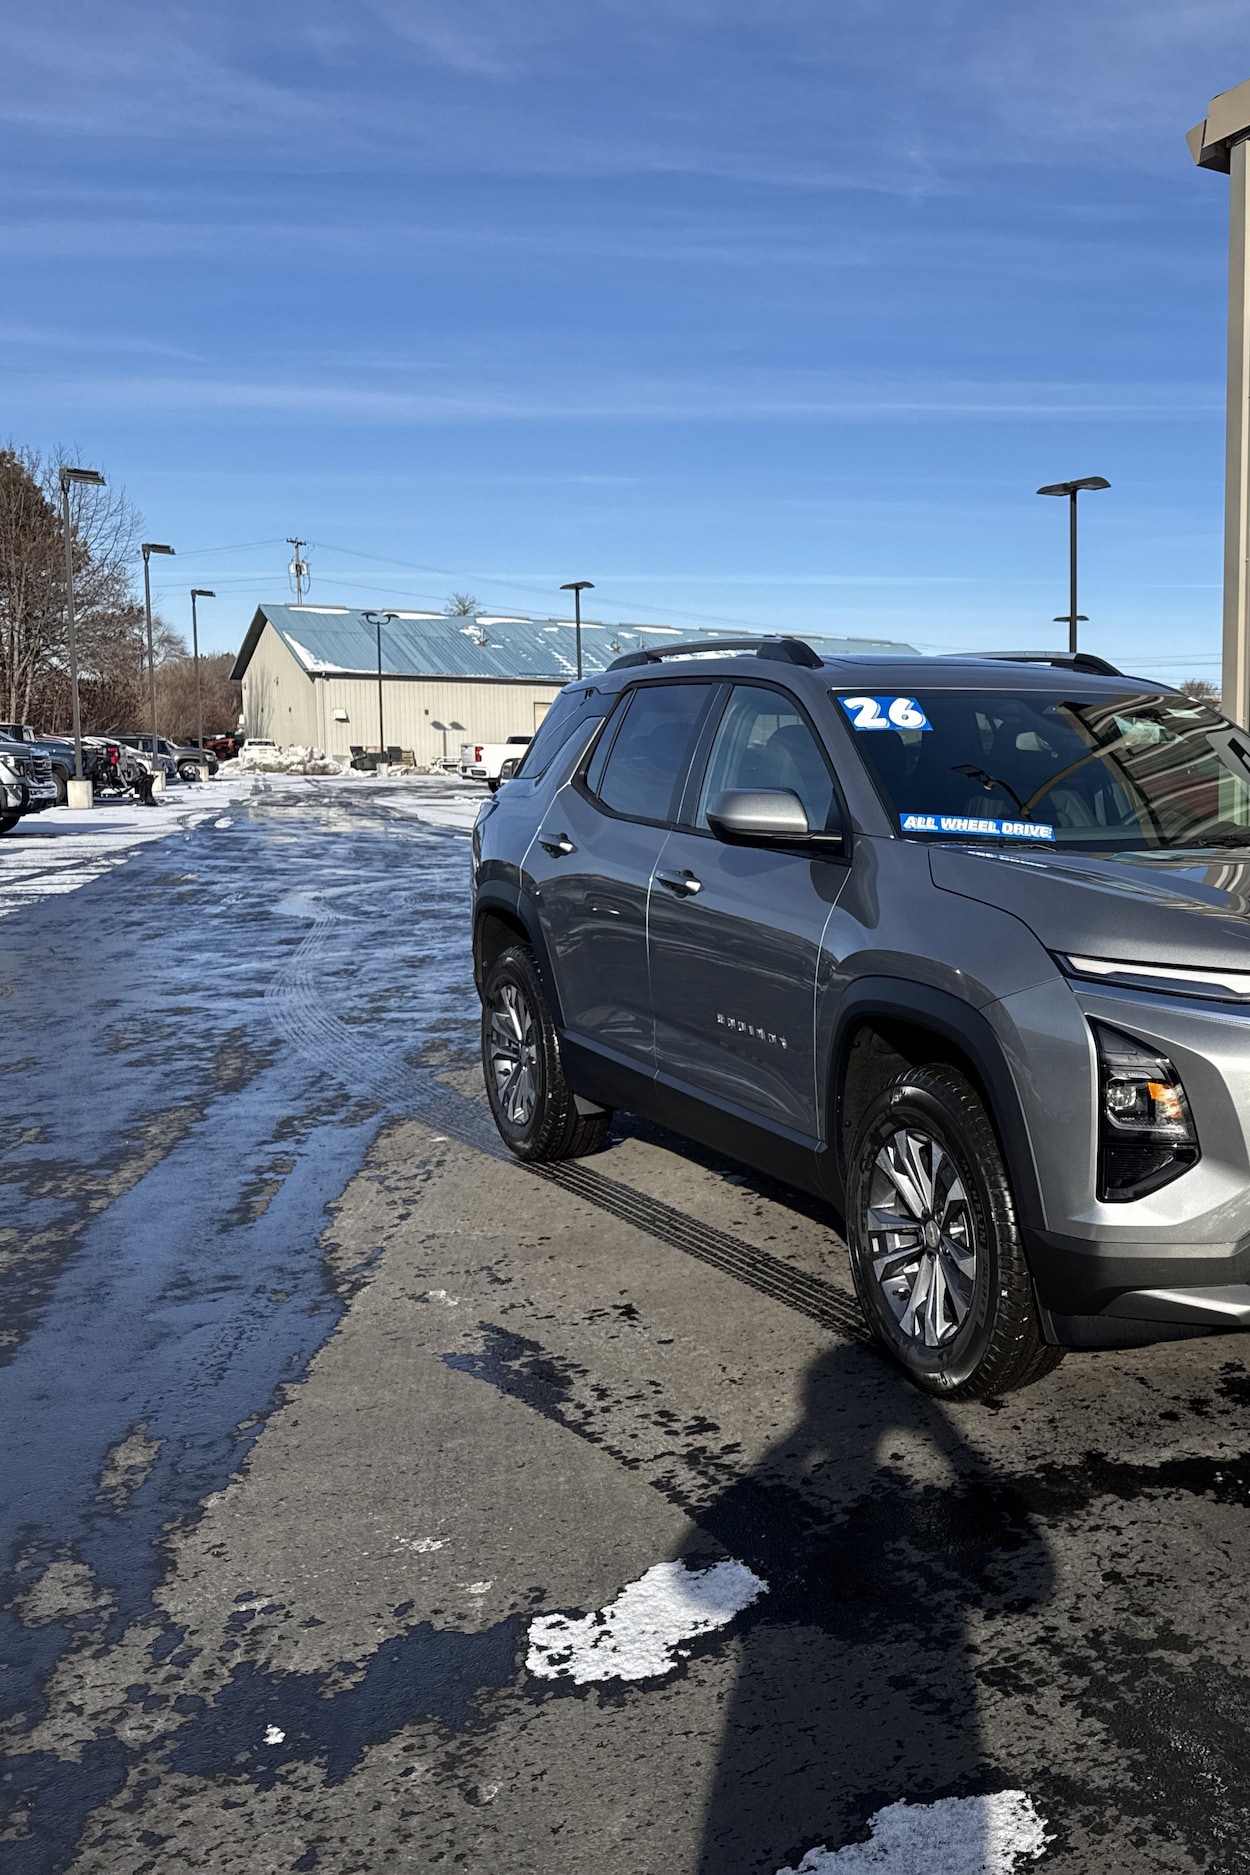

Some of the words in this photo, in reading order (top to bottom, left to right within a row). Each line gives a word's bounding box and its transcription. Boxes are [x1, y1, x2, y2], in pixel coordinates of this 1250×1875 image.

[843, 697, 927, 729] 26
[903, 815, 938, 830] ALL
[940, 817, 1000, 834] WHEEL
[1001, 822, 1052, 839] DRIVE
